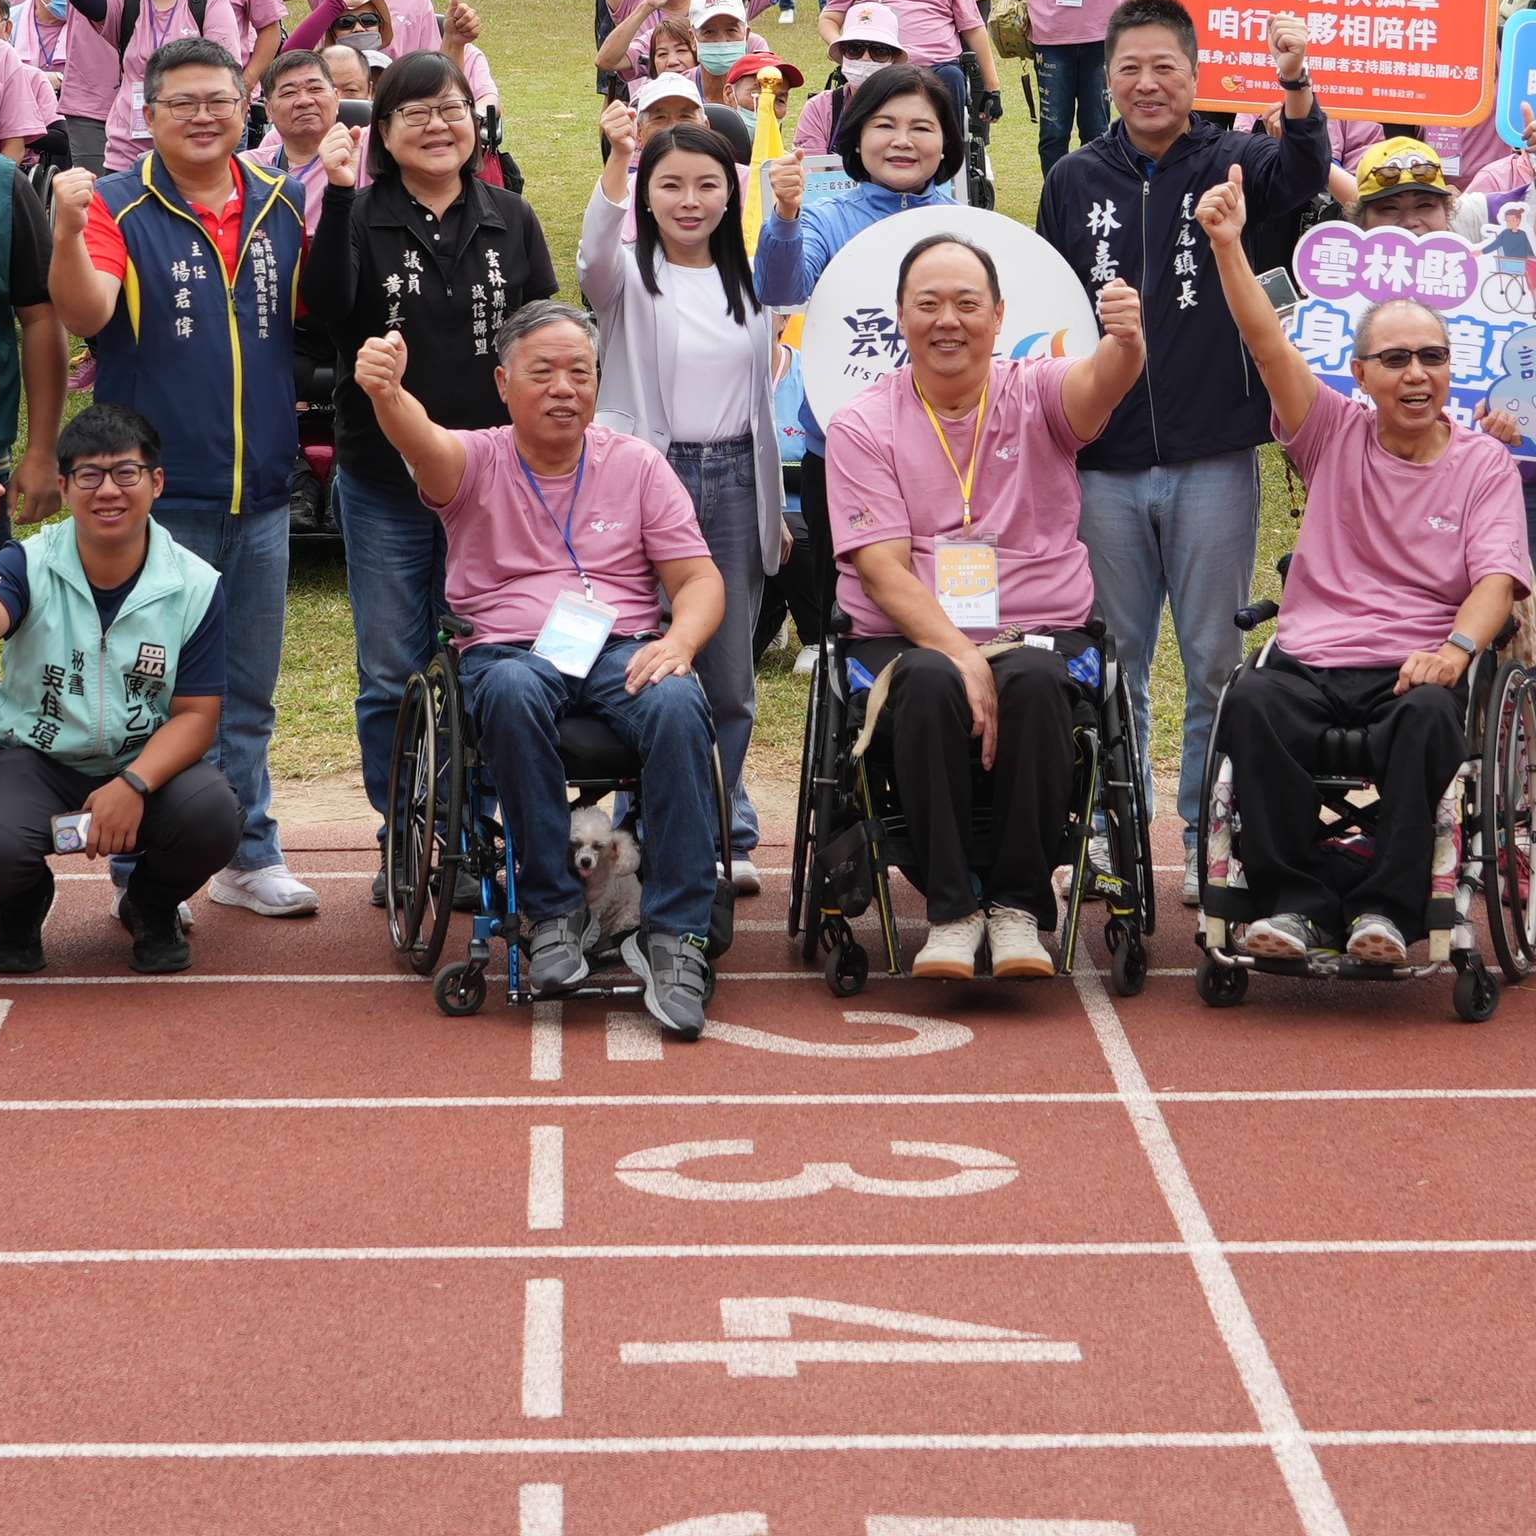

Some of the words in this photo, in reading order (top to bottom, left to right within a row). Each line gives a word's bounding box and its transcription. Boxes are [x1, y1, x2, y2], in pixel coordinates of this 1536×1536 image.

[1208, 8, 1438, 52] 咱行夥相陪伴
[191, 241, 207, 280] 主任
[402, 249, 424, 295] 議員
[1086, 198, 1122, 315] 林嘉
[1309, 237, 1468, 298] 雲林縣
[171, 261, 195, 339] 楊君偉
[471, 283, 488, 356] 誠信聯盟
[613, 1137, 1020, 1202] 3
[618, 1296, 1082, 1378] 4
